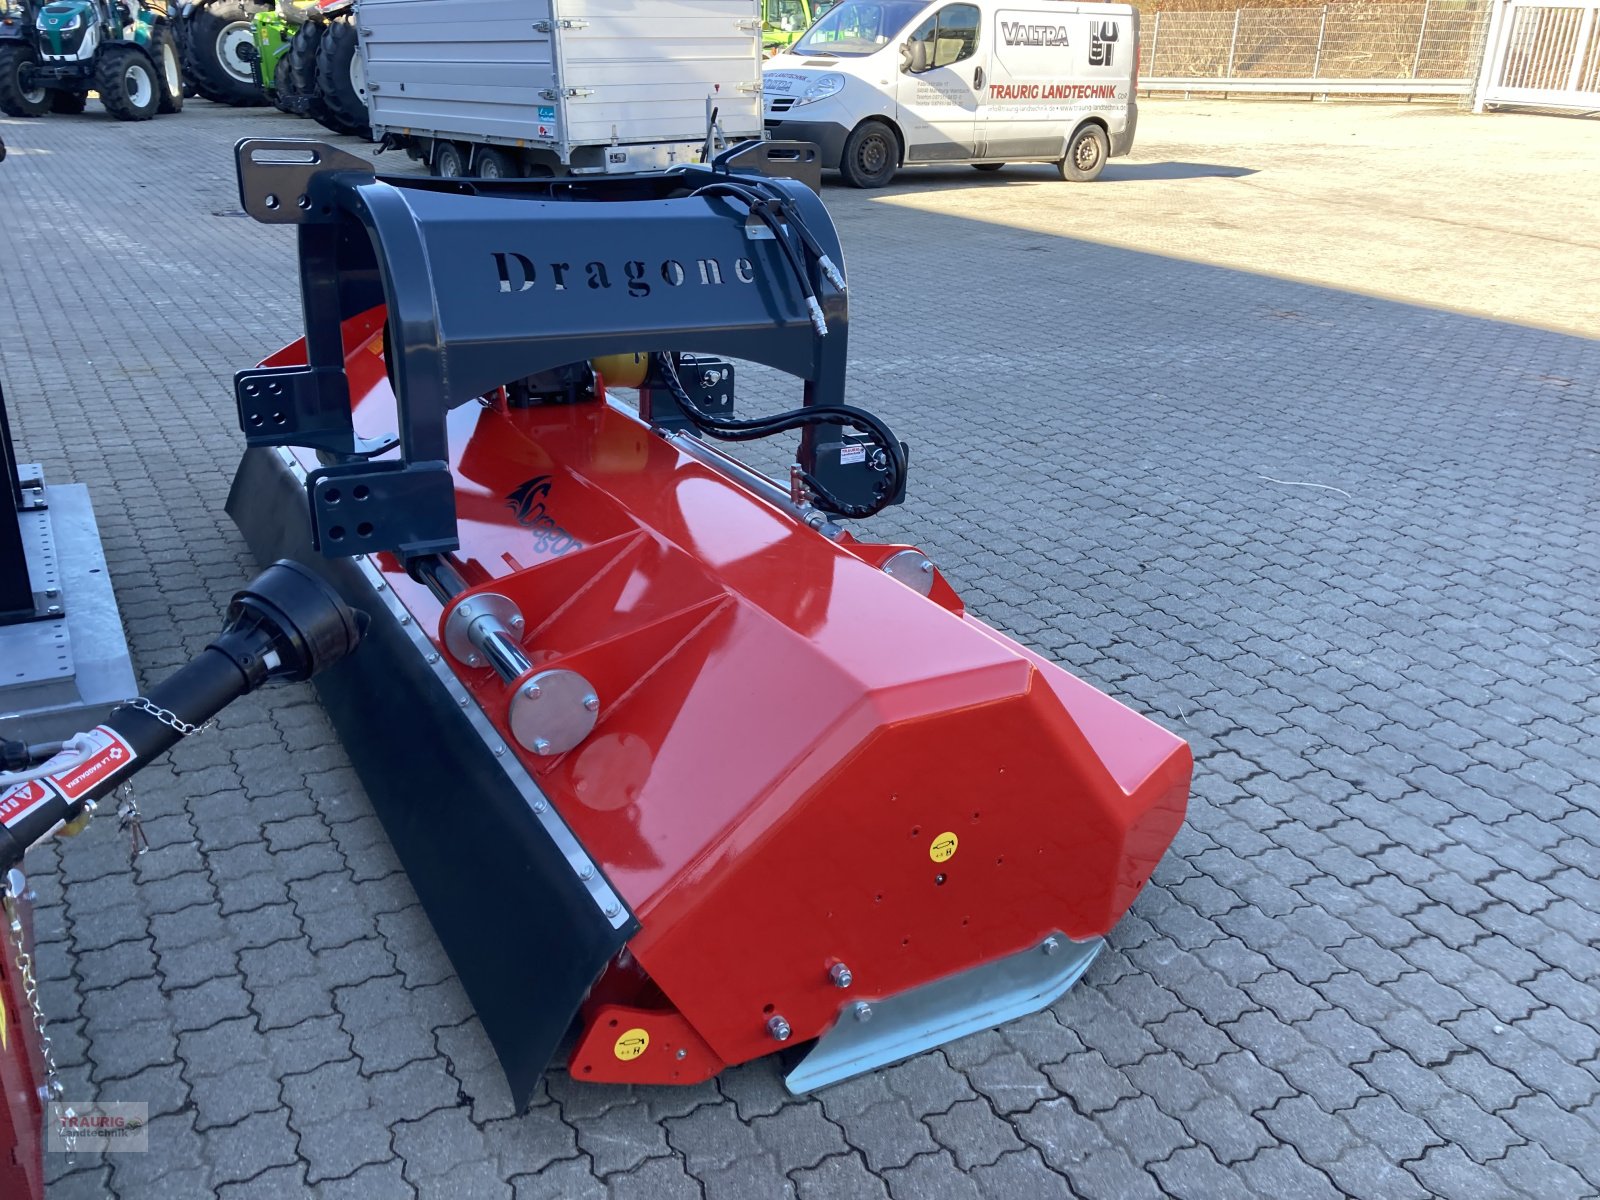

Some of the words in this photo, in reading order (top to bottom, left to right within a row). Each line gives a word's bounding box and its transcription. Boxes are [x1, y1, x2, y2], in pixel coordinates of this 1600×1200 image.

[1000, 21, 1069, 46] VALTRA
[989, 84, 1039, 99] TRAURIG
[1041, 84, 1117, 99] LANDTECHNIK
[490, 252, 754, 297] Dragone
[100, 757, 111, 765] LA
[65, 762, 102, 789] MAGDALENA
